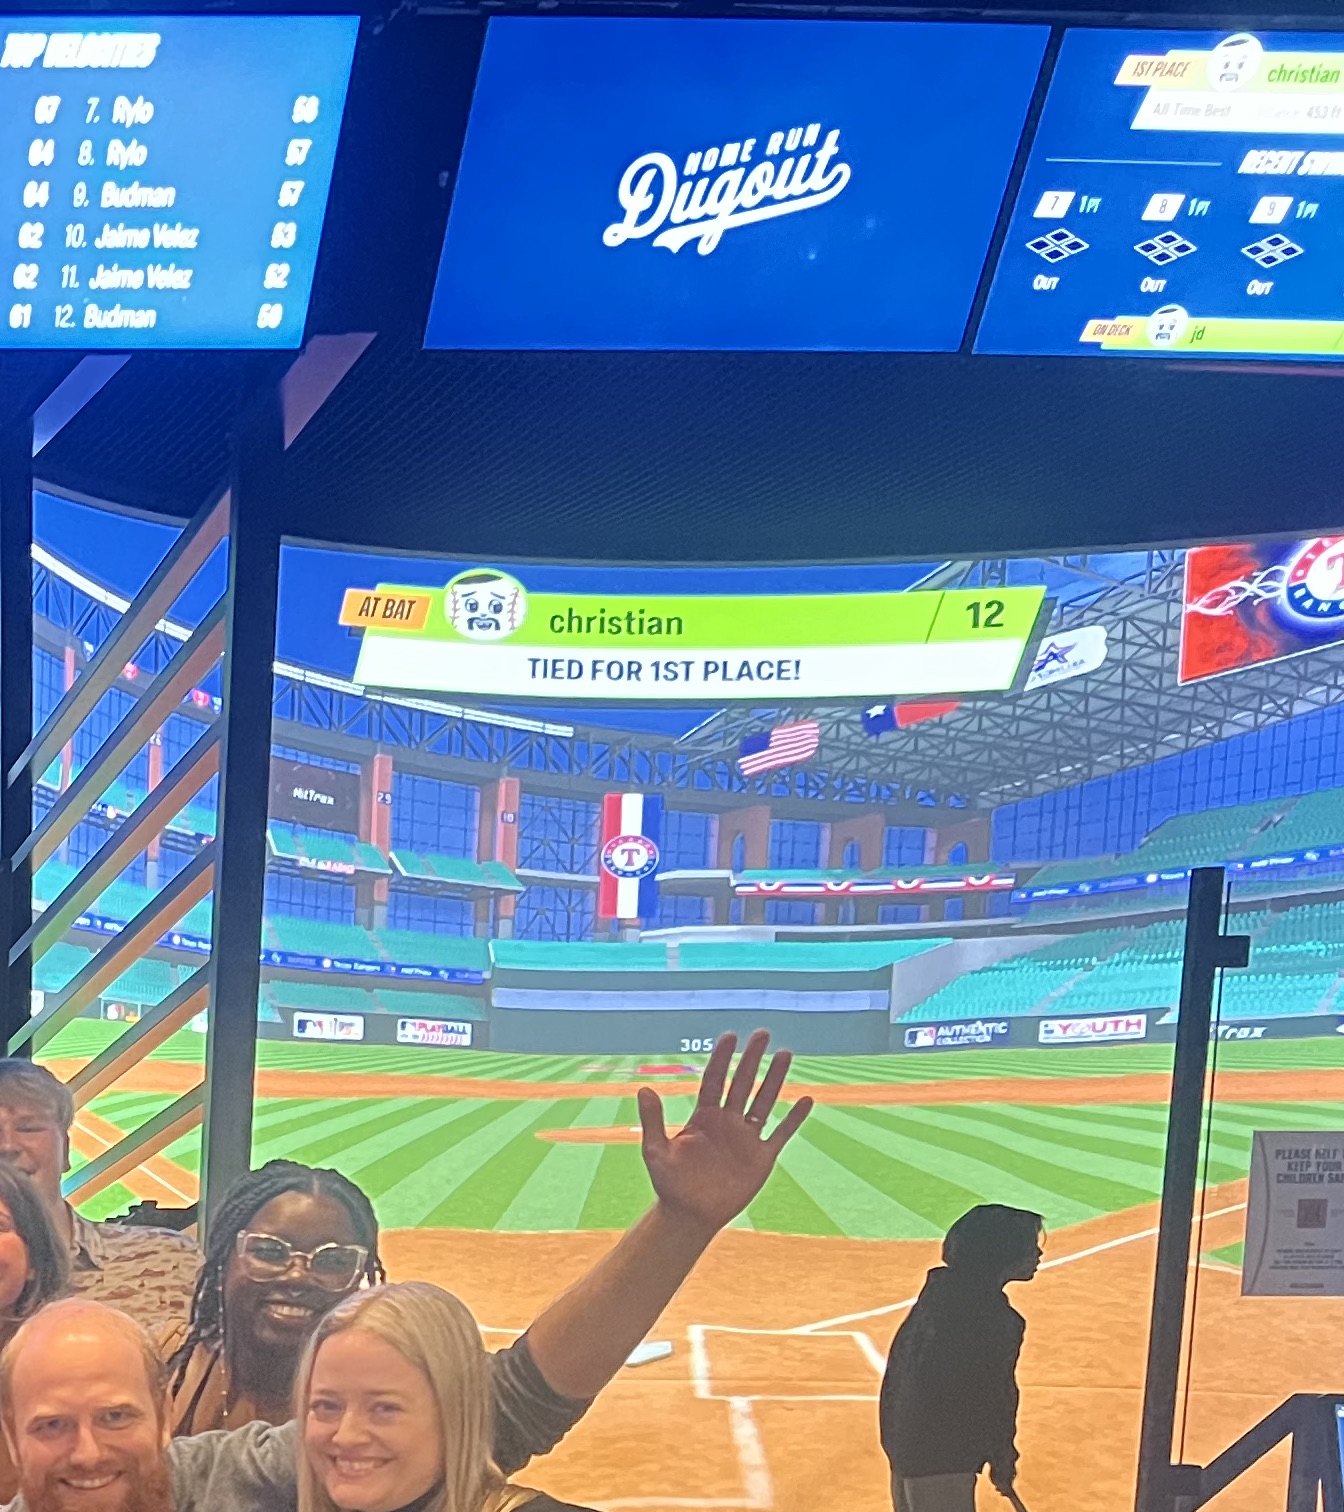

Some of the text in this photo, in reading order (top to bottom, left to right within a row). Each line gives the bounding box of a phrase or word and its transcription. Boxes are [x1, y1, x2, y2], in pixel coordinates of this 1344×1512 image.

[1267, 64, 1341, 84] christian
[683, 122, 822, 177] HOME RUN
[603, 127, 852, 256] Dugout
[1190, 325, 1205, 343] jd
[358, 597, 417, 621] AT BAT
[548, 606, 685, 638] christian
[965, 600, 1006, 631] 12
[526, 657, 802, 683] TIED FOR 1ST PLACE!
[1059, 1018, 1142, 1036] YOUTH
